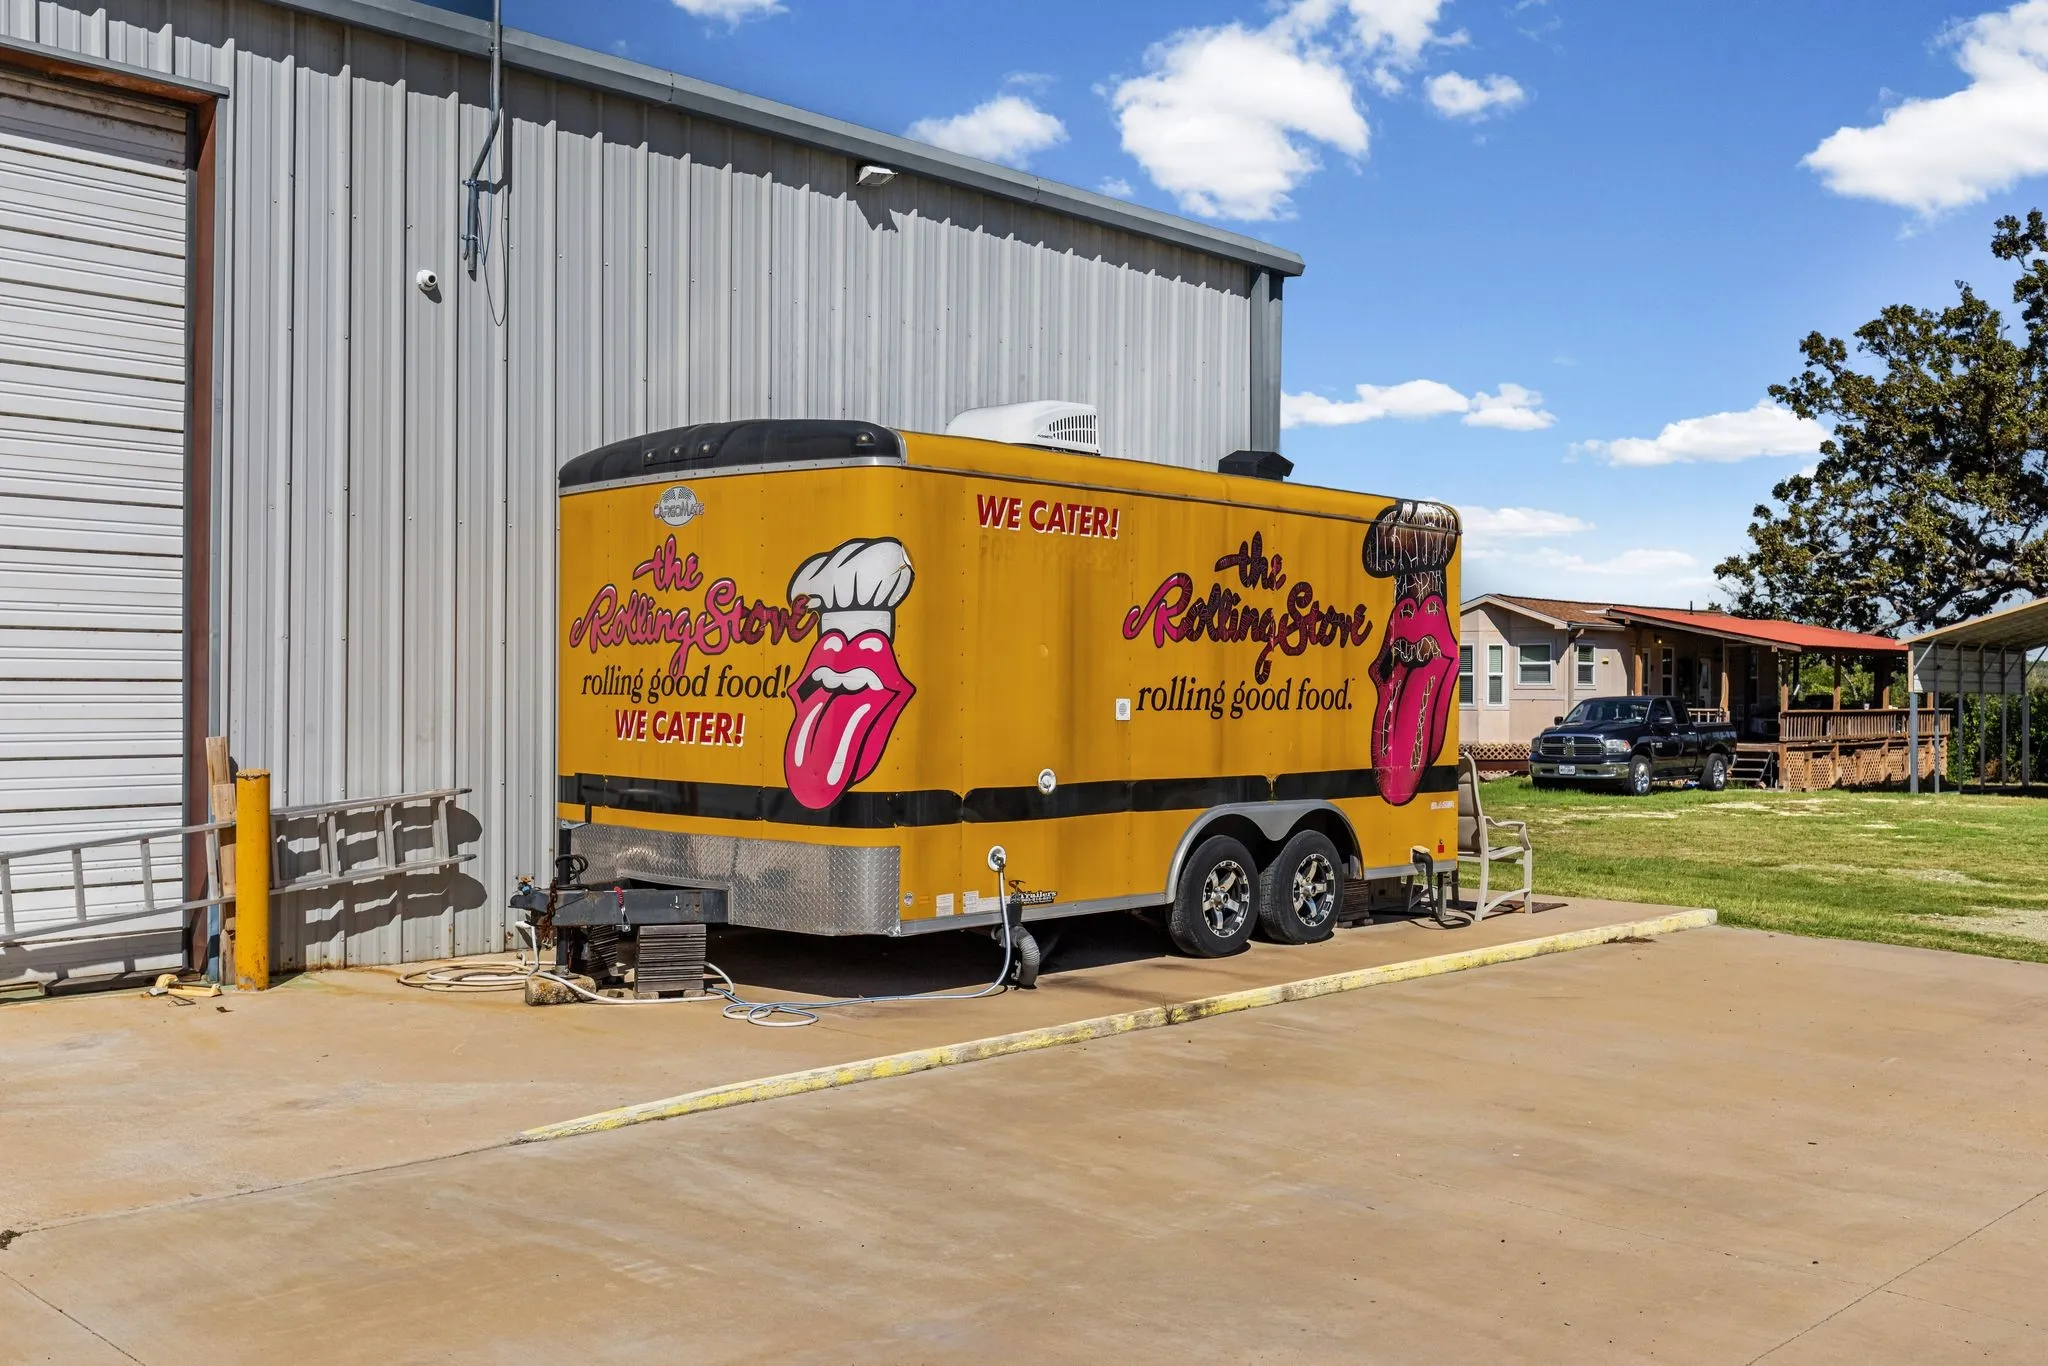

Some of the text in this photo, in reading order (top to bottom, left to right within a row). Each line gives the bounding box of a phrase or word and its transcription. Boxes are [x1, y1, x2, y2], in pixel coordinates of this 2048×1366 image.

[976, 493, 1120, 540] WE CATER!
[633, 533, 703, 593] the
[1214, 530, 1287, 591] the
[569, 577, 818, 679] Rolling Stove
[1122, 572, 1373, 685] Rolling Stove
[581, 664, 791, 704] rolling good food!
[1135, 675, 1225, 720] rolling
[1229, 677, 1292, 720] good
[615, 709, 746, 746] WE CATER!
